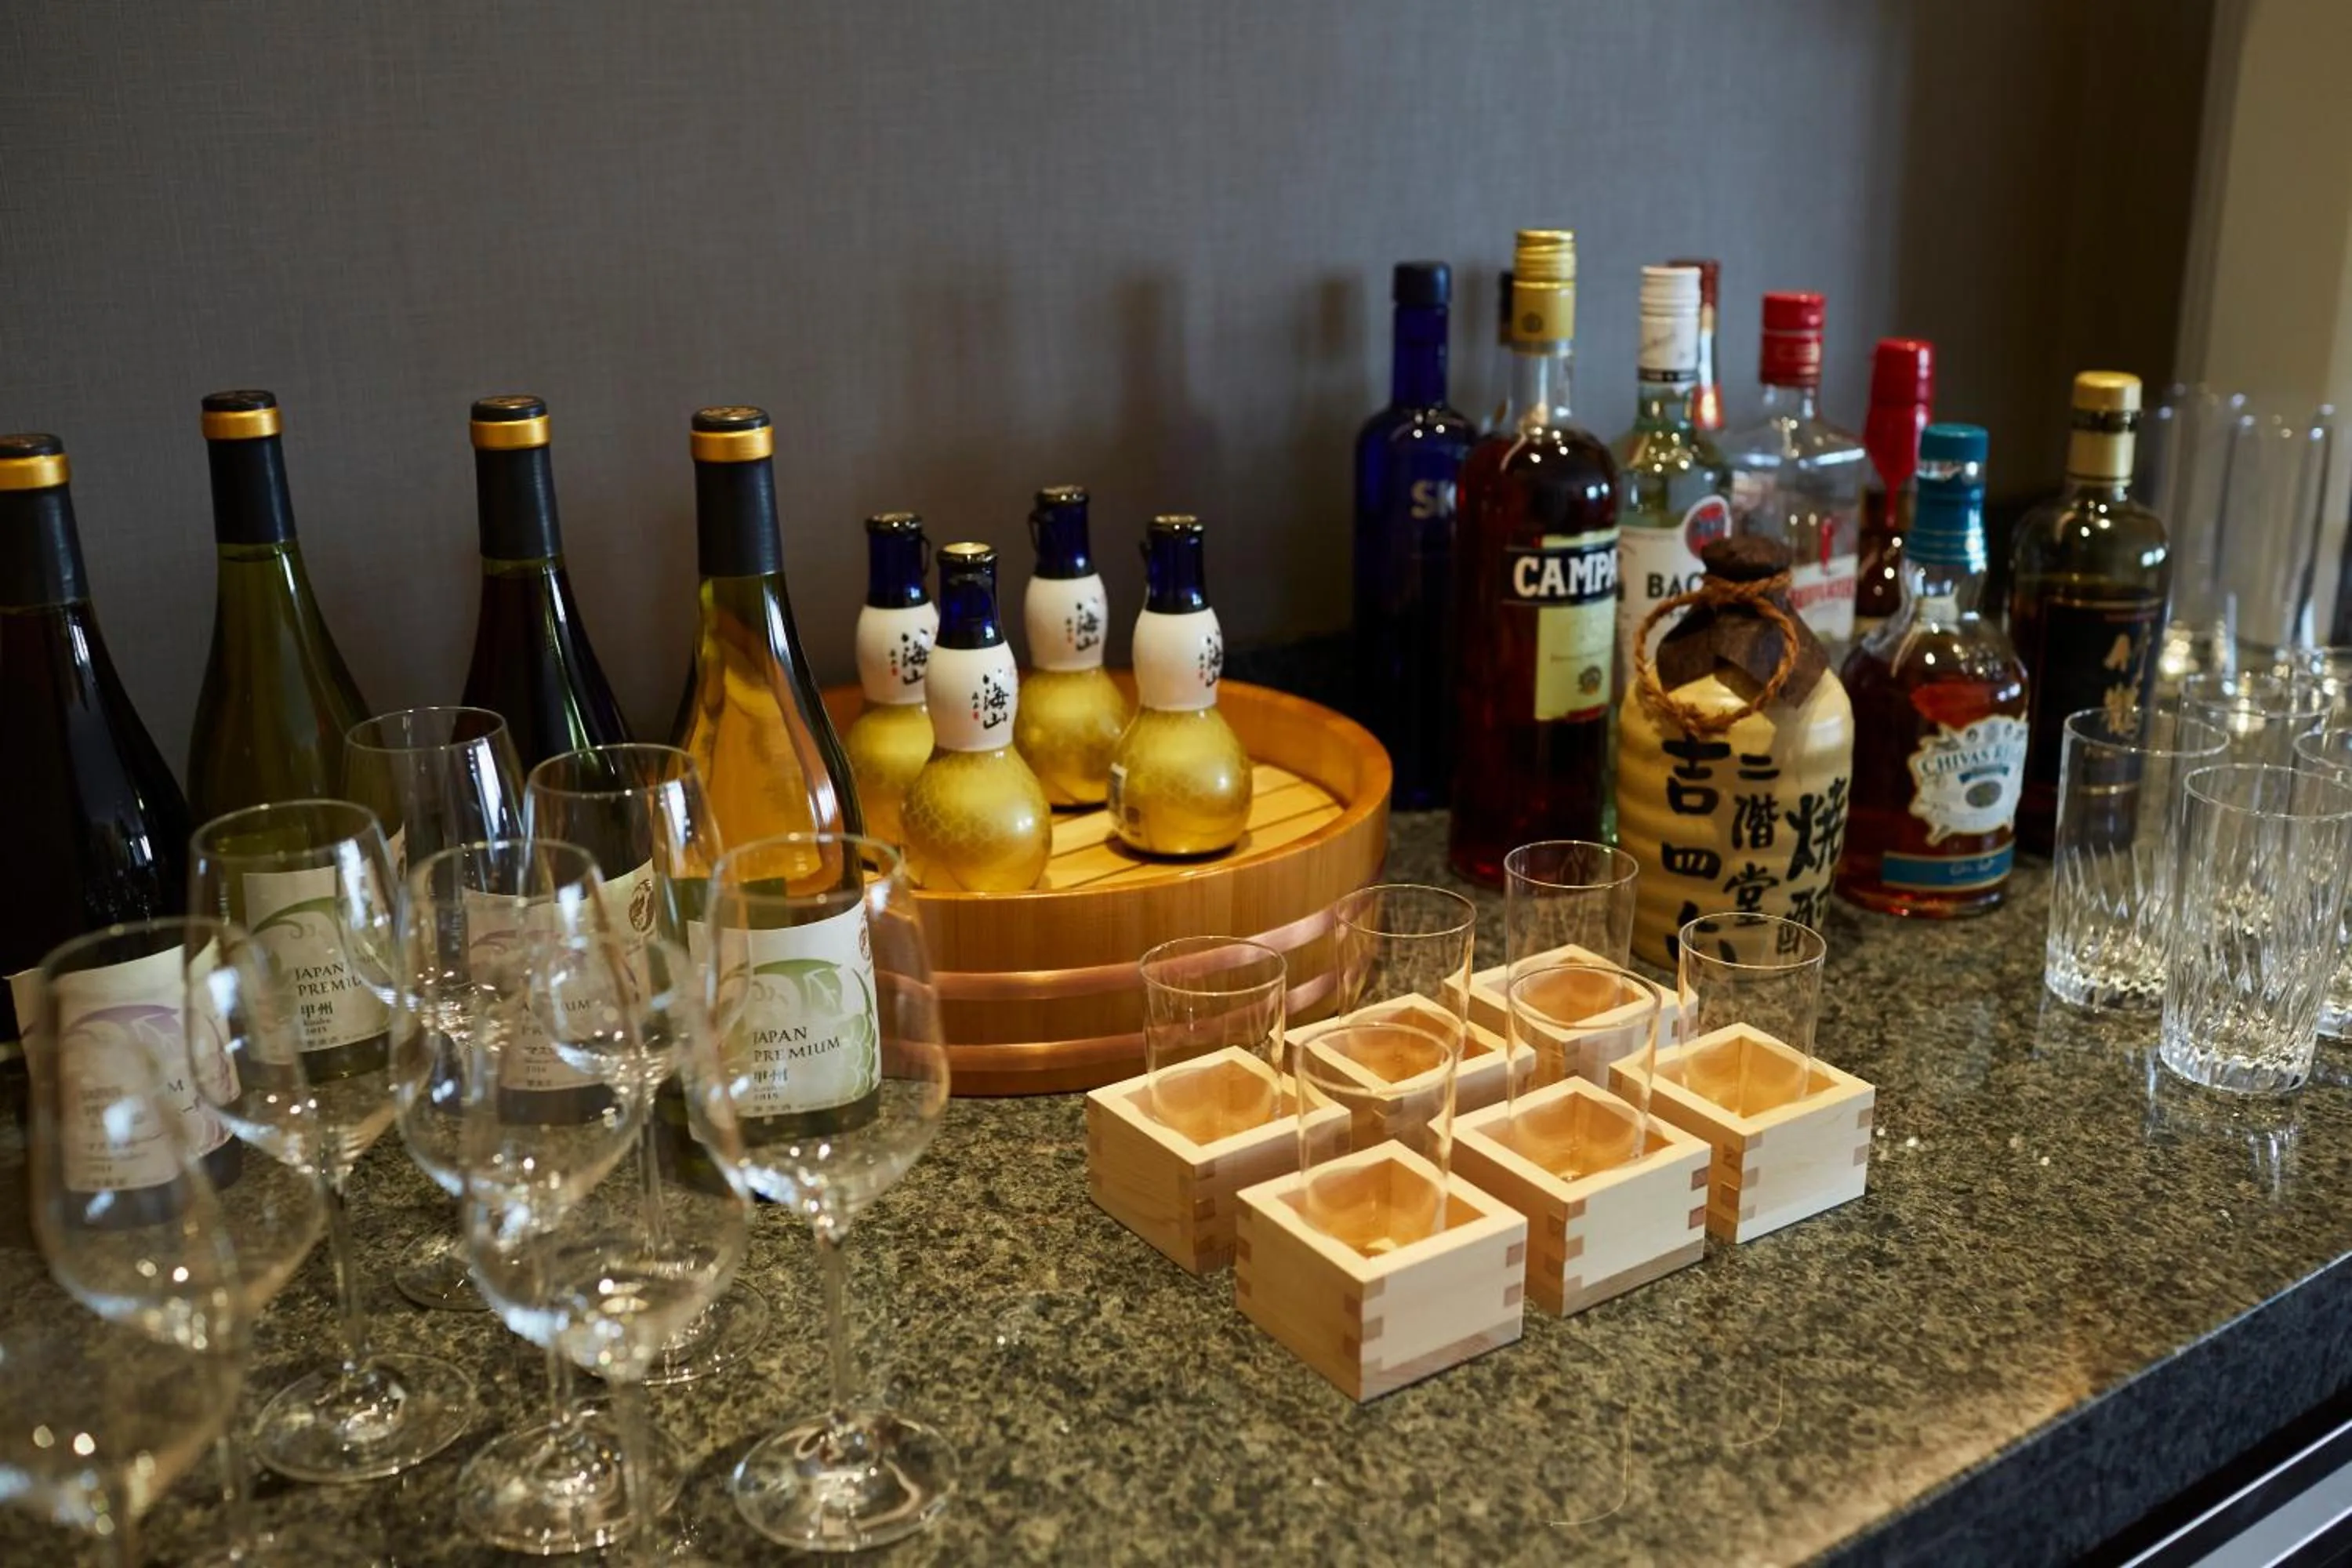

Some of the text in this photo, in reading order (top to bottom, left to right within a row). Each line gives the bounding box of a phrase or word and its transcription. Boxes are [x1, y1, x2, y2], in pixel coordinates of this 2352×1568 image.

[1722, 753, 1780, 927] 二階堂
[295, 964, 344, 981] JAPAN
[753, 1026, 808, 1045] JAPAN
[753, 1035, 840, 1062] PREMIUM
